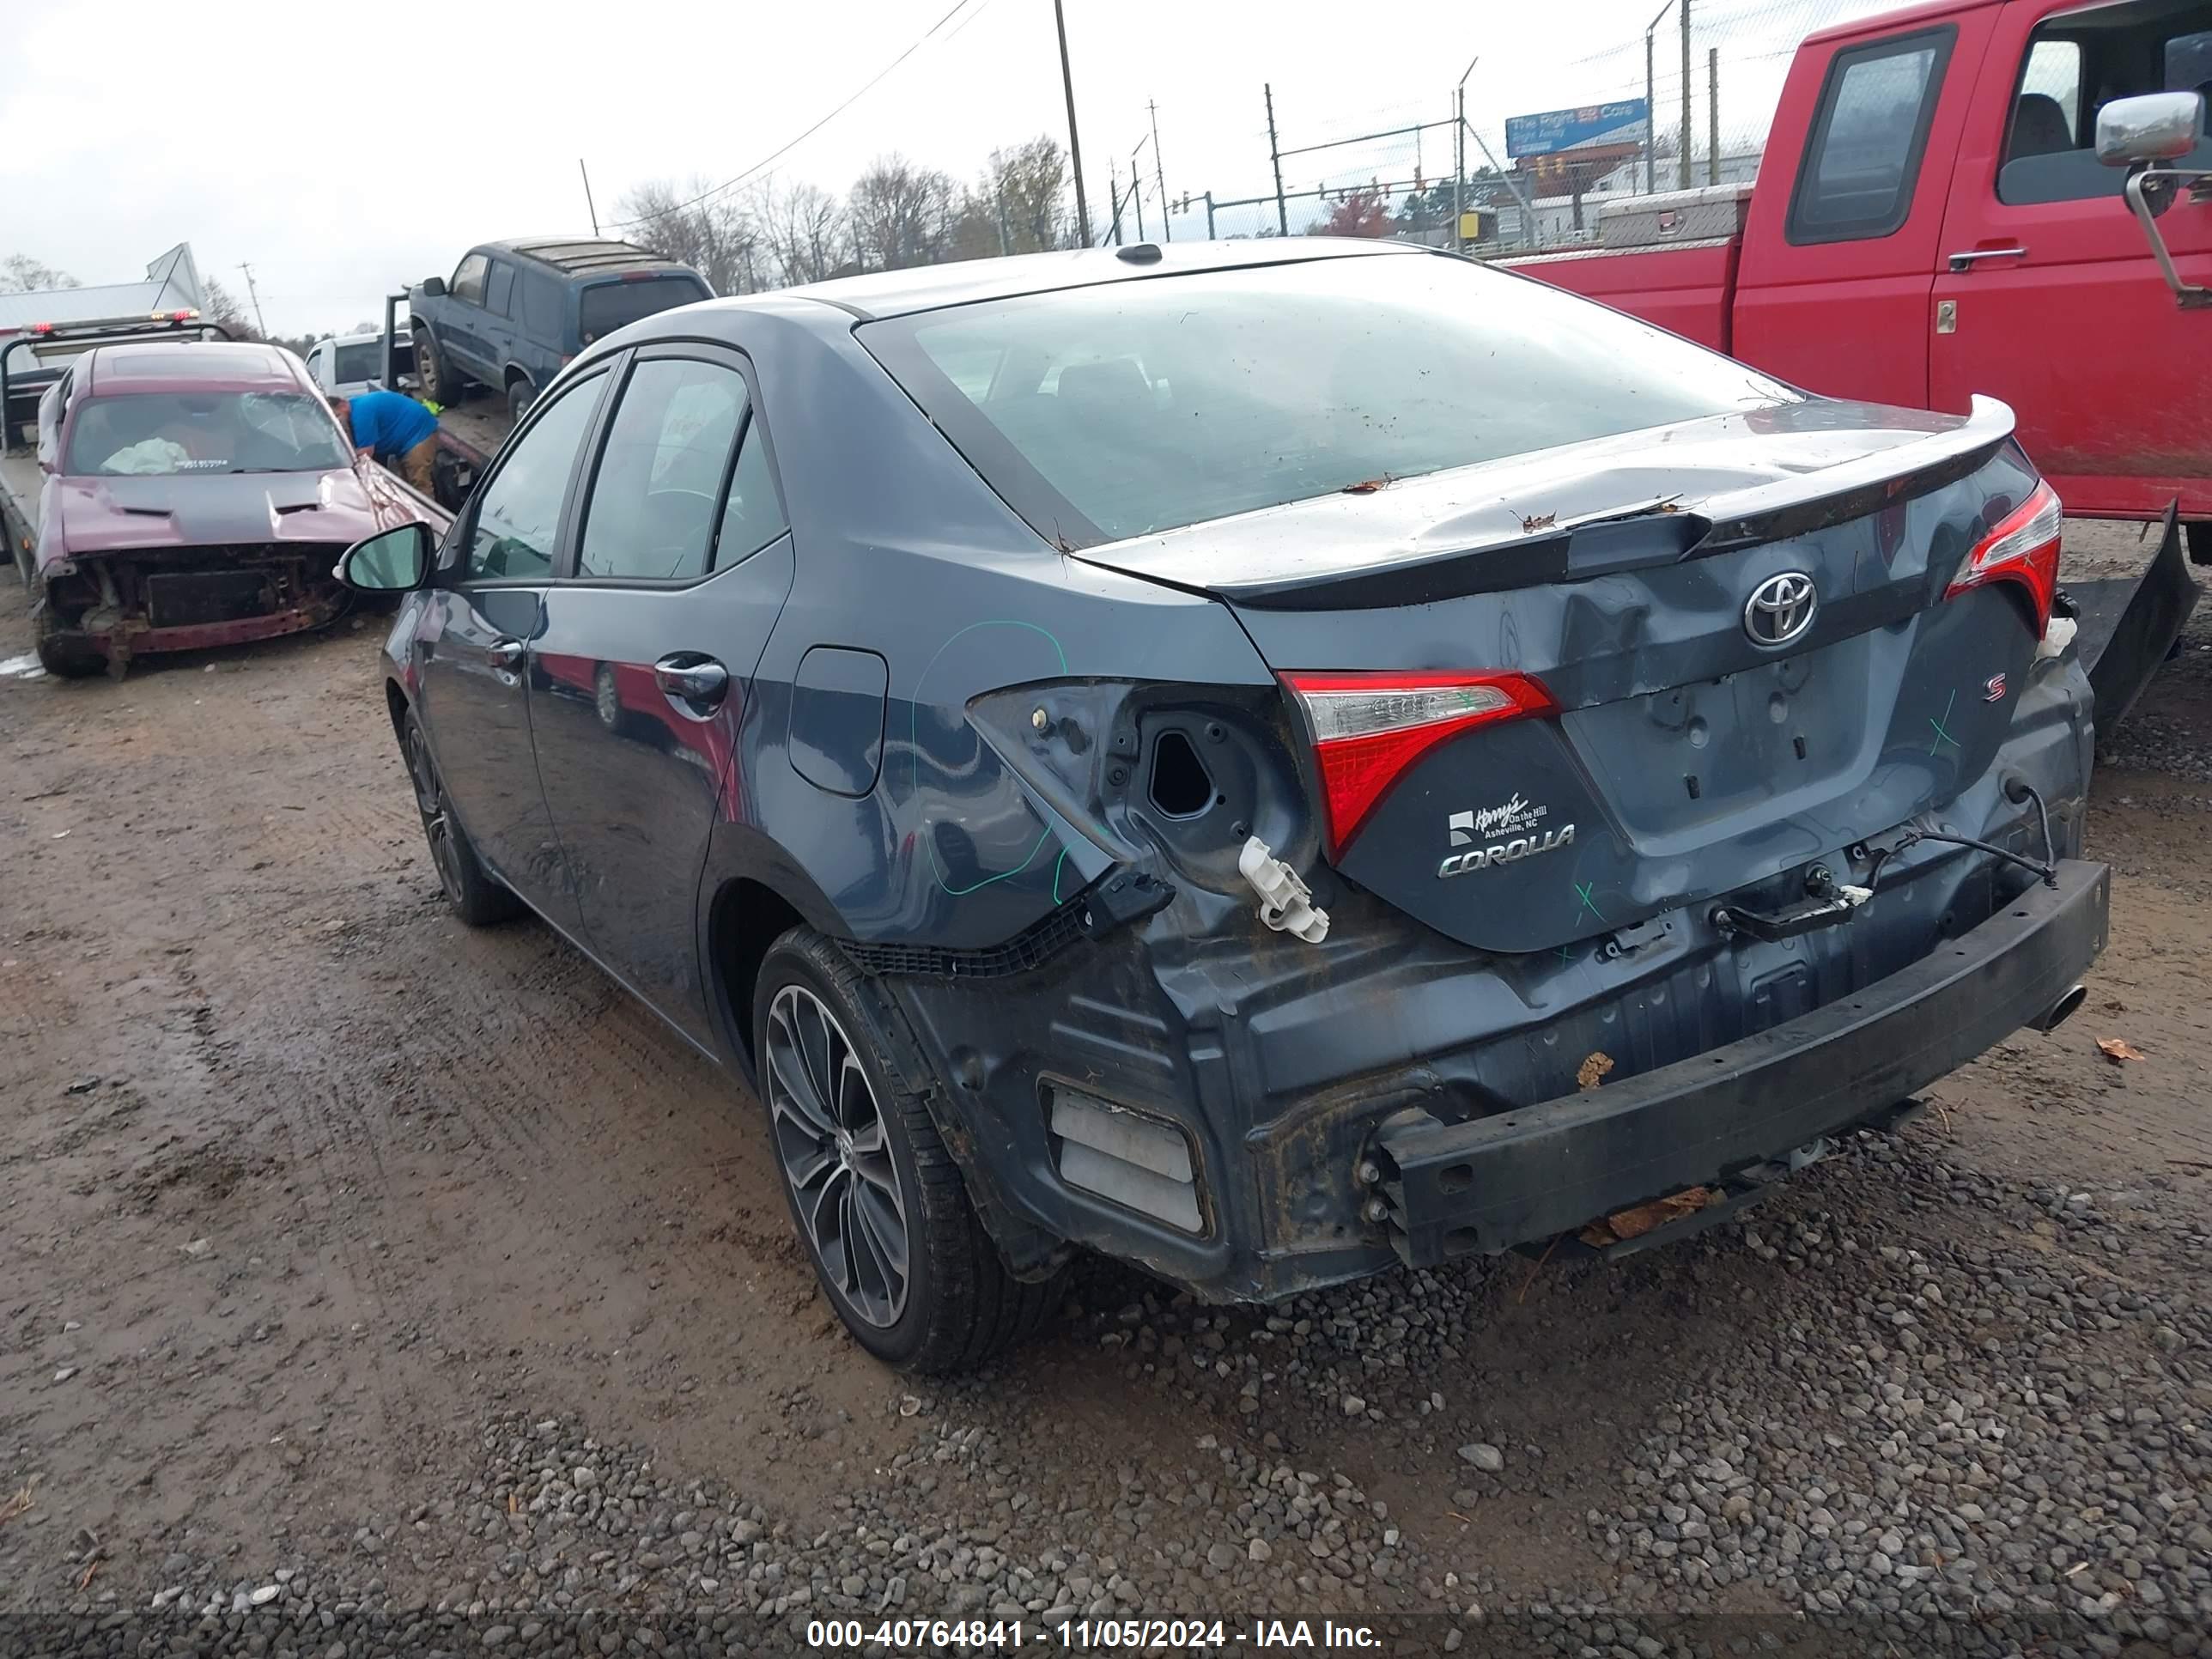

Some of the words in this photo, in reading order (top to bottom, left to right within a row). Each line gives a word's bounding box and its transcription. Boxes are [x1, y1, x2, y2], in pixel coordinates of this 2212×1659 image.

[1511, 118, 1537, 130] The
[1601, 105, 1633, 118] Care
[1984, 672, 2006, 702] S
[1510, 814, 1520, 823] On
[1521, 810, 1532, 821] the
[1533, 805, 1547, 818] Hill
[1485, 824, 1525, 839] Asheville,
[1525, 818, 1538, 830] NC
[1437, 823, 1575, 879] COROLLA
